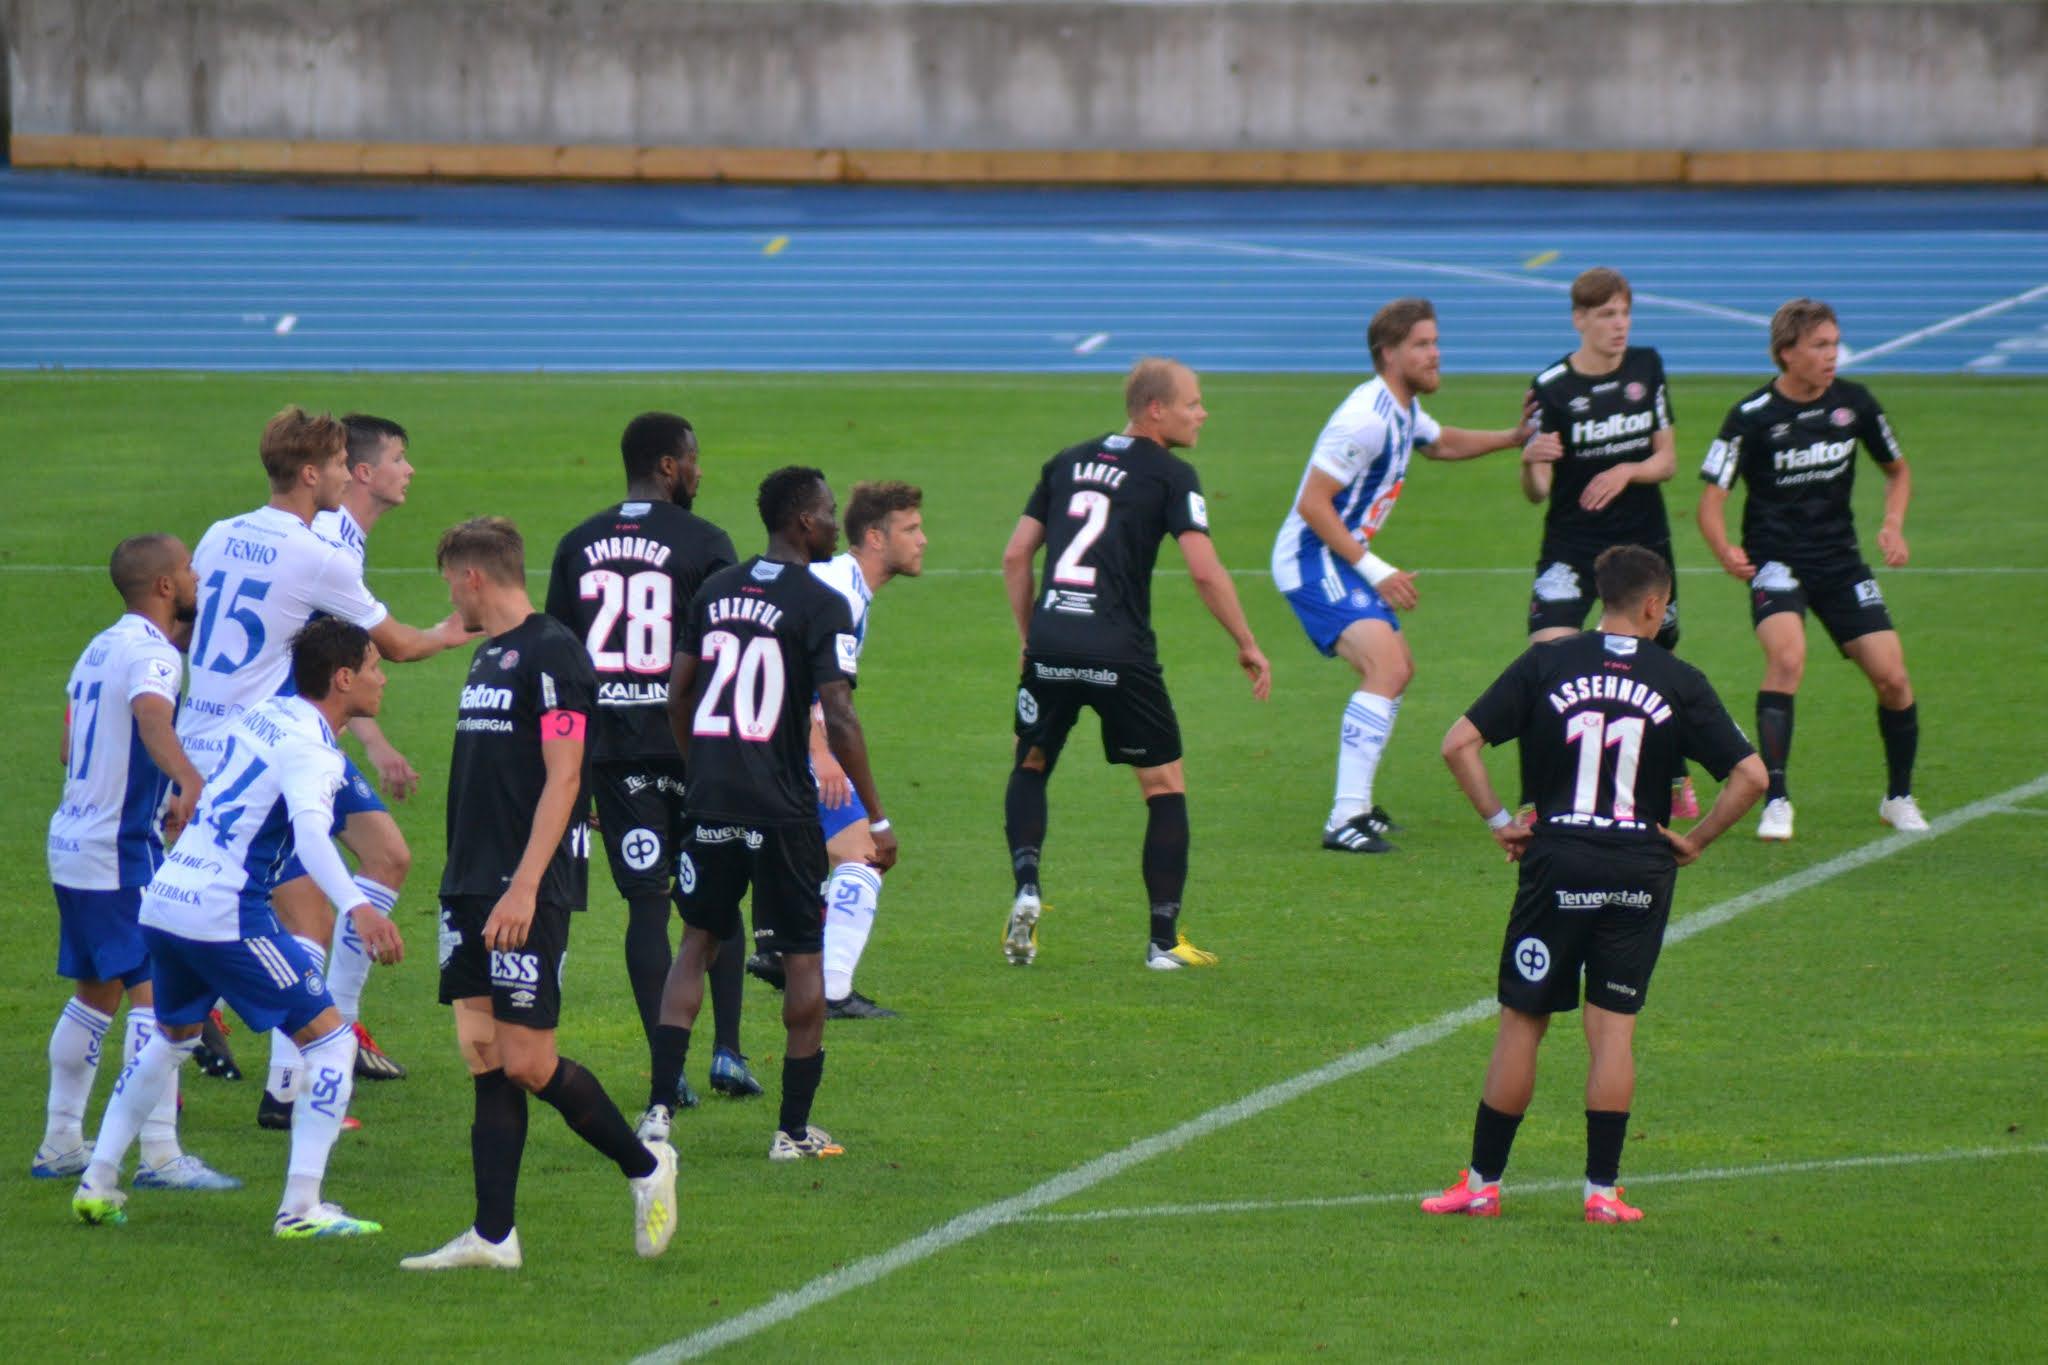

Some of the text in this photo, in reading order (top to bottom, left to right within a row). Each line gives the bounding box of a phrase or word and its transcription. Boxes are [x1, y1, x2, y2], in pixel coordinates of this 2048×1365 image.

[1572, 410, 1653, 443] Halton
[223, 536, 277, 565] TENHO
[584, 536, 671, 568] IMBONGO
[1053, 490, 1110, 587] 2
[192, 569, 272, 675] 15
[579, 569, 673, 673] 28
[692, 630, 785, 742] 20
[1034, 662, 1119, 682] Terveystalo
[1549, 675, 1673, 725] ASSEHNOUN
[69, 681, 103, 780] 17
[1566, 710, 1647, 822] 11
[1556, 890, 1653, 906] Terveystalo
[491, 949, 539, 983] ESS
